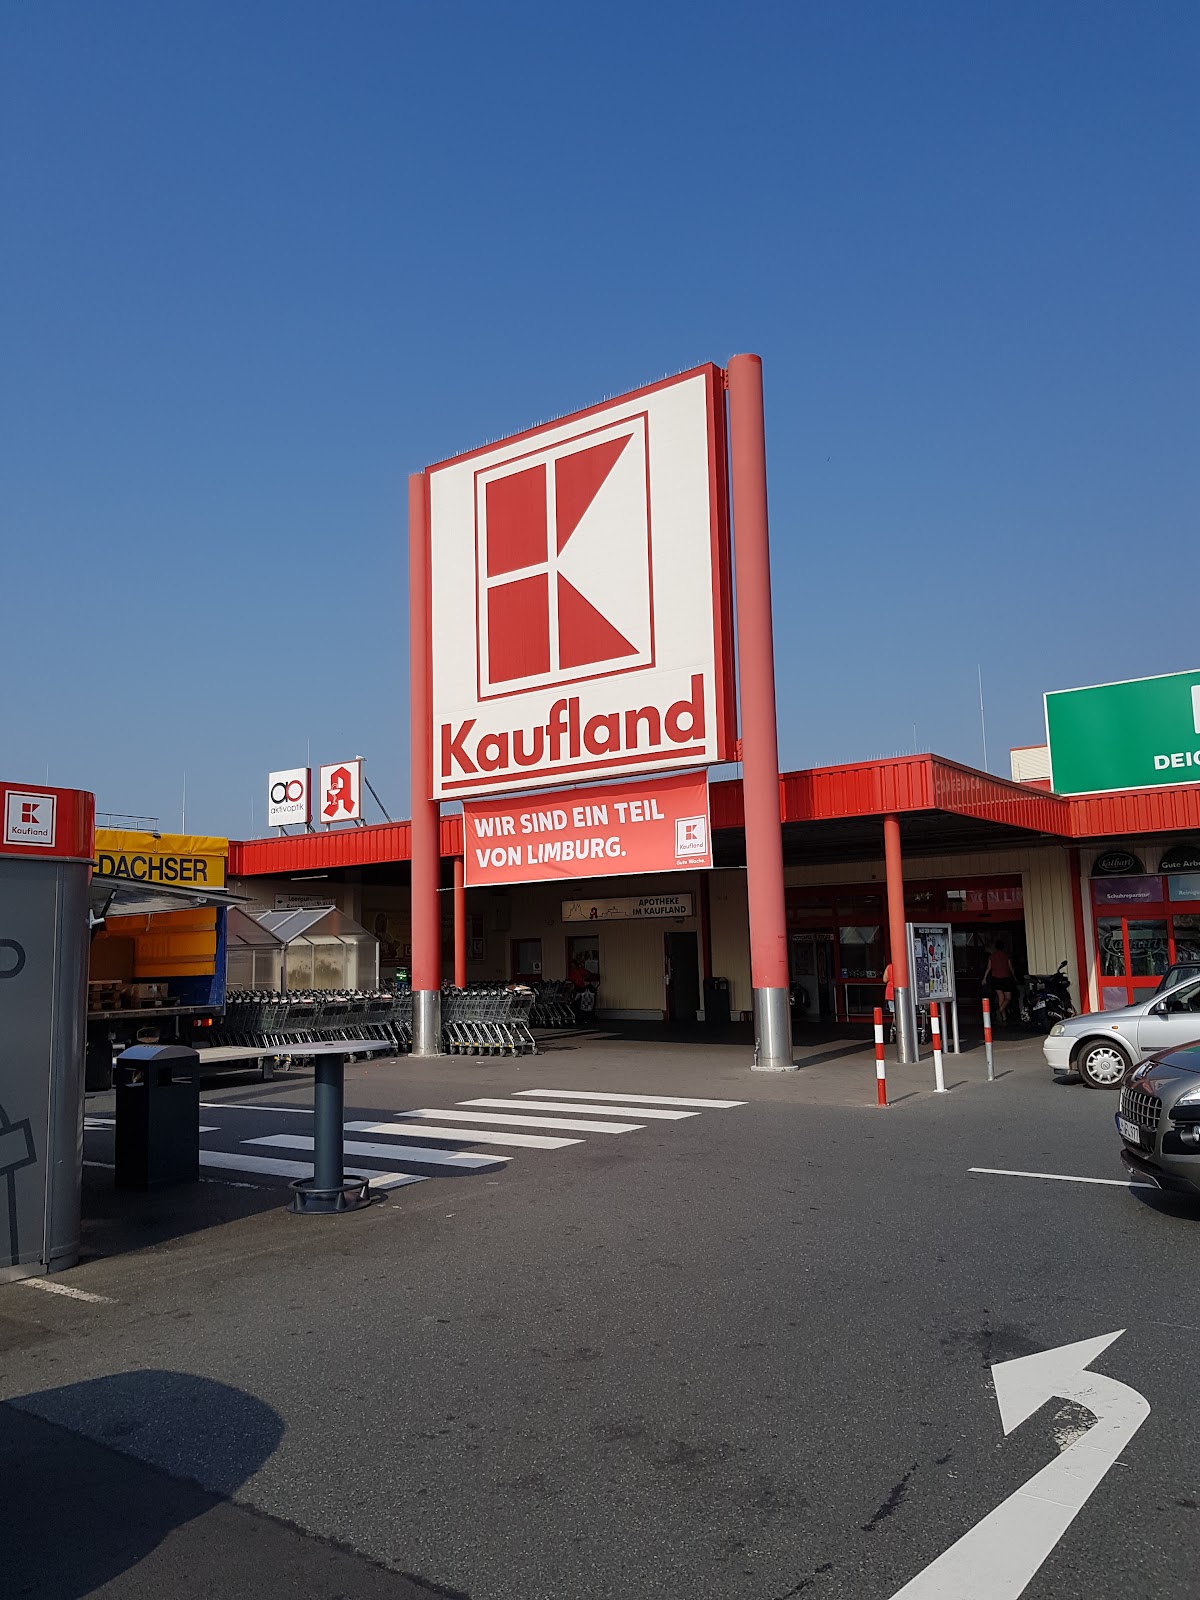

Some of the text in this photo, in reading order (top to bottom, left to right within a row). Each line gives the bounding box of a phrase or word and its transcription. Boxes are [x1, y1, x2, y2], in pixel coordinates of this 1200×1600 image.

[441, 673, 706, 778] Kaufland
[270, 803, 304, 815] aktivoptik
[474, 798, 665, 838] WIR SIND EIN TEIL
[11, 826, 48, 836] Kaufland
[680, 841, 704, 850] Kaufland
[475, 837, 627, 869] VON LIMBURG.
[98, 854, 208, 882] DACHSER
[1161, 861, 1181, 869] Gute
[638, 897, 680, 906] APOTHEKE
[632, 905, 687, 916] IM KAUFLAND
